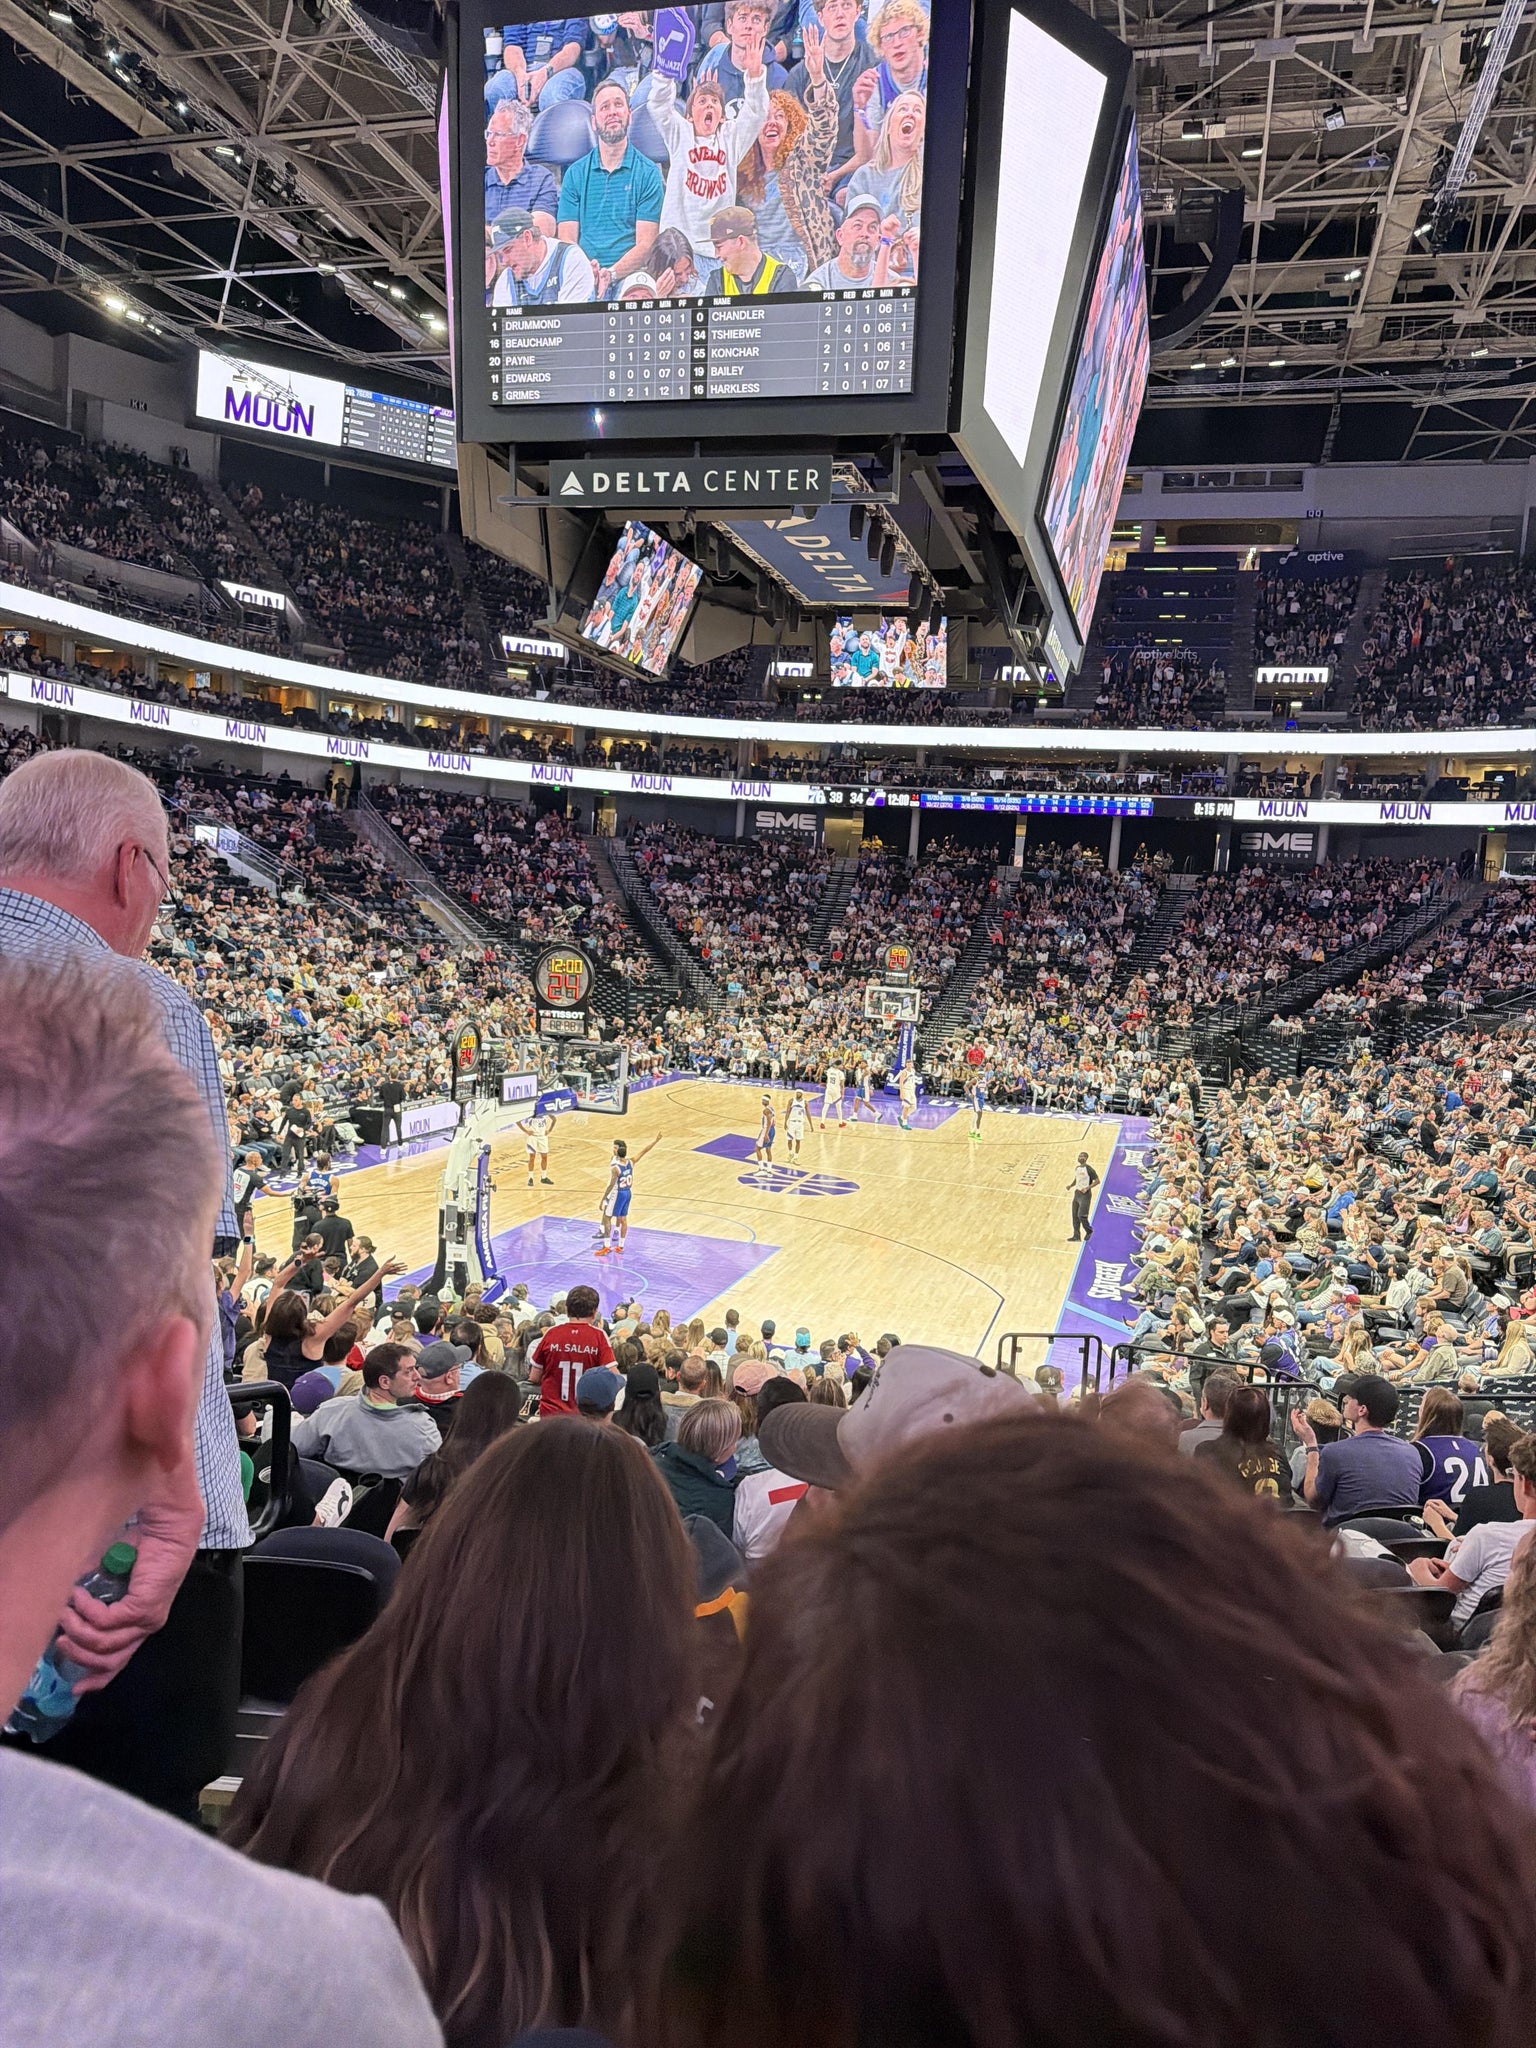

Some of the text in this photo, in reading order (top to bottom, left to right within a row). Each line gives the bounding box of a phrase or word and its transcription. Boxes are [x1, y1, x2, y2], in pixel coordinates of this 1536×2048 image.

[608, 302, 619, 310] PTS
[642, 301, 653, 309] AST
[659, 300, 671, 308] MIN
[714, 297, 731, 305] NAME
[823, 292, 835, 300] PTS
[862, 290, 875, 298] AST
[880, 289, 893, 297] MIN
[697, 312, 704, 322] 0
[712, 309, 765, 321] CHANDLER
[825, 306, 831, 316] 2
[845, 305, 852, 315] 0
[865, 305, 870, 314] 1
[878, 304, 892, 314] 06
[492, 323, 497, 331] 1
[505, 320, 560, 331] DRUMMOND
[609, 317, 616, 326] 0
[629, 316, 633, 325] 1
[644, 315, 651, 324] 0
[659, 314, 672, 323] 04
[693, 330, 706, 340] 34
[711, 329, 761, 339] TSHIEBWE
[824, 325, 831, 335] 4
[845, 324, 851, 334] 4
[863, 323, 870, 333] 0
[878, 323, 891, 333] 06
[489, 339, 499, 348] 16
[505, 337, 563, 348] BEAUCHAMP
[609, 335, 615, 344] 2
[628, 334, 634, 343] 2
[644, 333, 651, 342] 0
[659, 332, 671, 341] 04
[489, 357, 500, 366] 20
[505, 356, 535, 365] PAYNE
[609, 353, 615, 362] 9
[629, 352, 633, 361] 1
[644, 351, 650, 360] 2
[659, 350, 671, 359] 07
[693, 349, 706, 358] 55
[711, 347, 759, 358] KONCHAR
[824, 344, 831, 354] 2
[844, 343, 850, 353] 0
[863, 343, 868, 352] 1
[877, 342, 890, 351] 06
[491, 375, 499, 383] 11
[505, 373, 551, 383] EDWARDS
[609, 371, 615, 380] 8
[627, 370, 634, 379] 0
[643, 369, 650, 378] 0
[658, 369, 670, 378] 07
[694, 367, 704, 376] 19
[711, 366, 744, 376] BAILEY
[823, 363, 830, 373] 7
[844, 362, 848, 371] 1
[862, 361, 868, 371] 0
[877, 360, 890, 370] 07
[492, 392, 498, 400] 5
[505, 390, 540, 399] GRIMES
[609, 388, 615, 396] 8
[627, 387, 633, 396] 2
[644, 387, 648, 396] 1
[659, 386, 669, 395] 12
[693, 385, 704, 394] 16
[710, 383, 760, 394] HARKLESS
[822, 381, 829, 390] 2
[842, 380, 849, 390] 0
[862, 380, 866, 389] 1
[876, 379, 889, 389] 07
[593, 469, 819, 493] DELTA CENTER
[784, 535, 874, 593] DELTA
[1307, 550, 1344, 564] aptive
[829, 791, 843, 803] 38
[850, 792, 863, 804] 34
[1194, 802, 1233, 816] 8:15 PM
[756, 810, 817, 830] SME
[1240, 832, 1313, 851] SME
[551, 959, 582, 973] 12:00
[889, 955, 905, 969] 24
[548, 973, 579, 1000] 24
[460, 1048, 472, 1066] 24
[620, 1174, 633, 1188] 20
[481, 1211, 493, 1268] AMERICA
[550, 1343, 599, 1355] M. SALAH
[1444, 1457, 1489, 1502] 24
